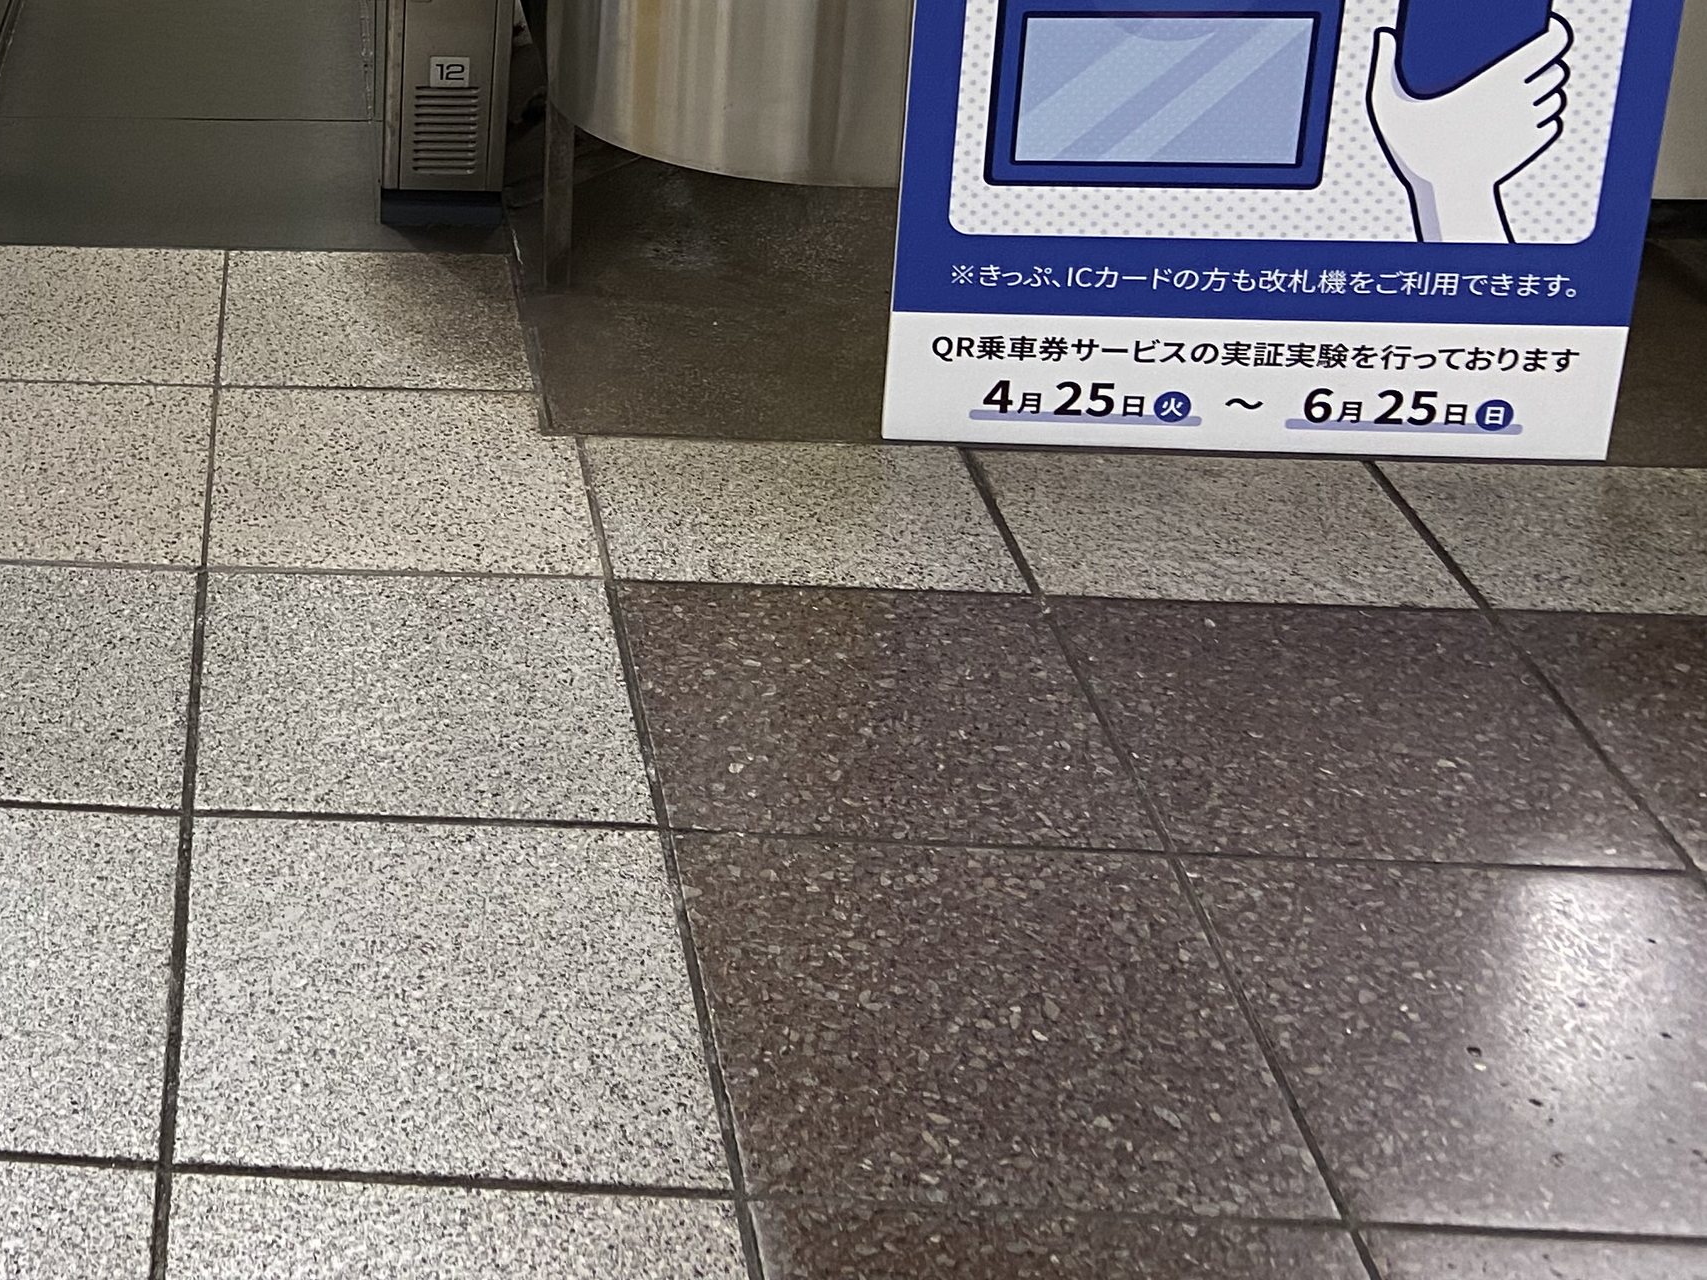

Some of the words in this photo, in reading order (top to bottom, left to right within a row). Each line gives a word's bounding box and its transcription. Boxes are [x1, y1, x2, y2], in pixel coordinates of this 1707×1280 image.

[436, 64, 465, 80] 12
[930, 334, 1581, 374] QR乗車券サービスの実証実験を行っております
